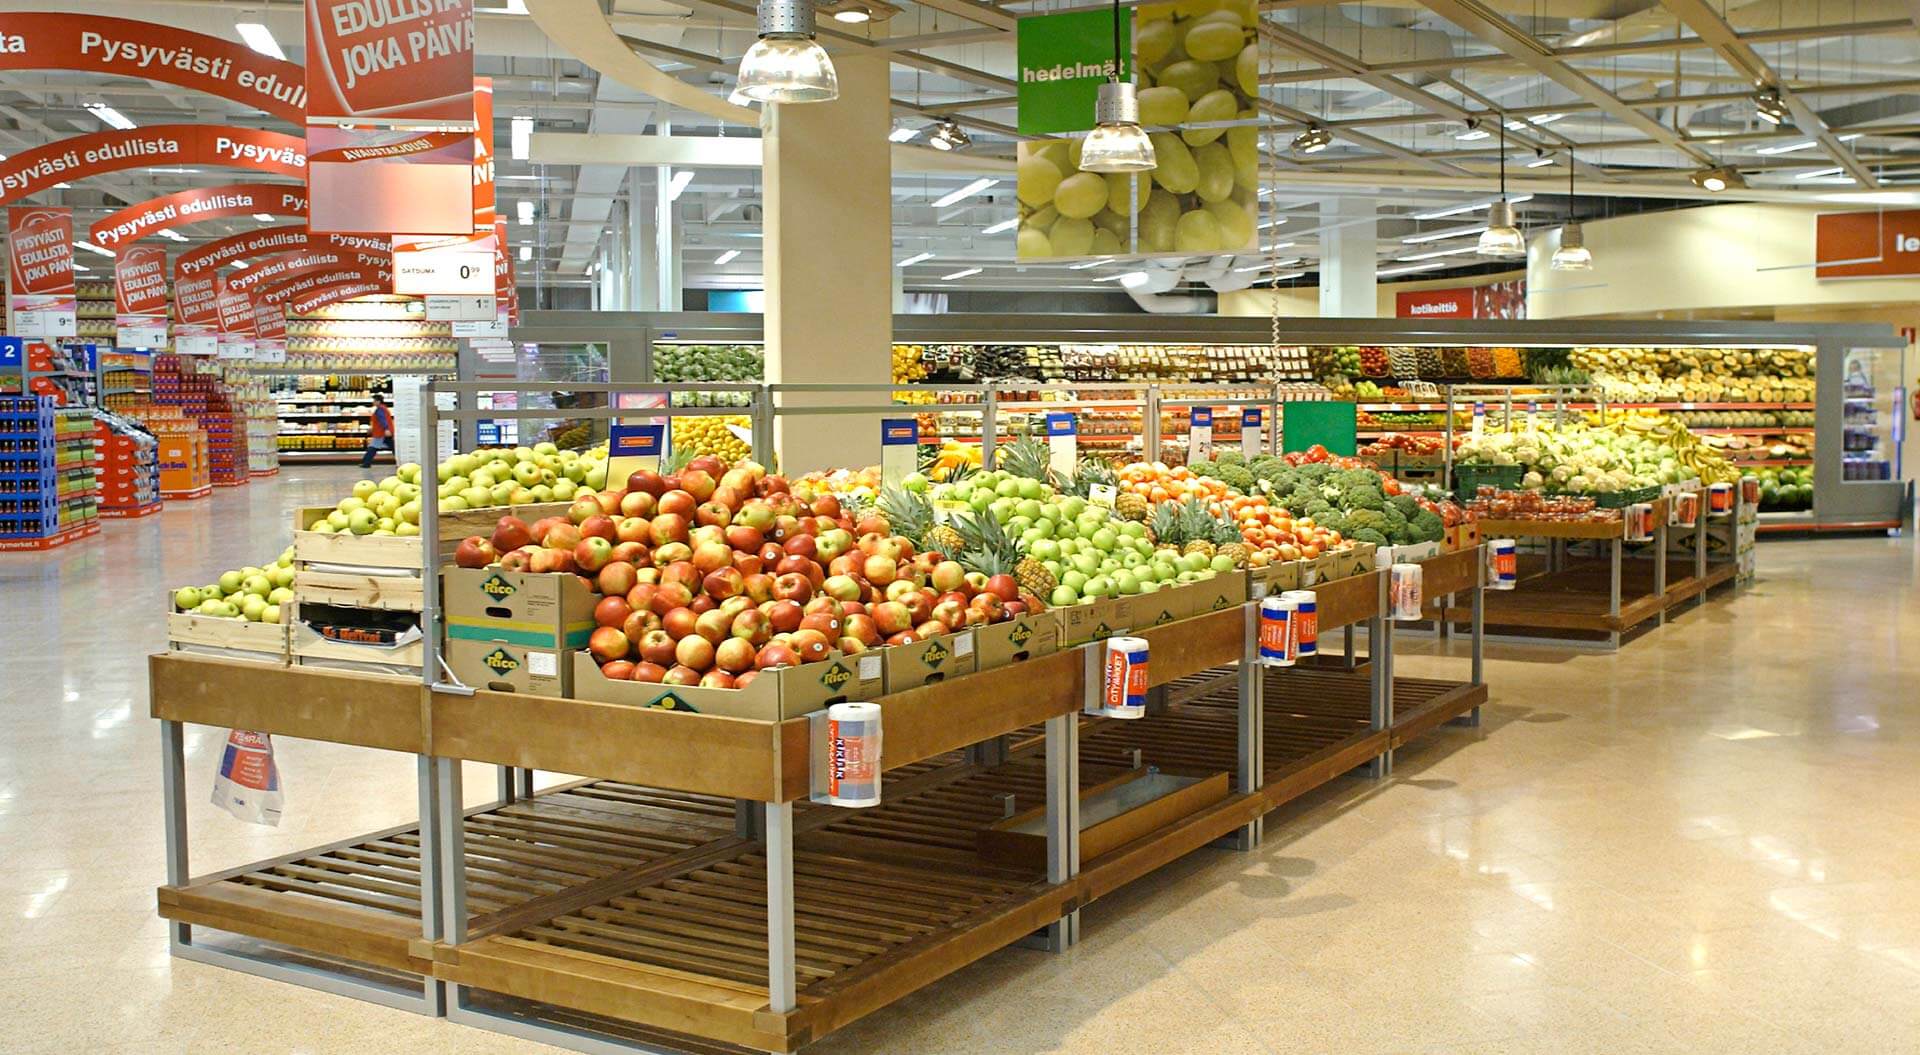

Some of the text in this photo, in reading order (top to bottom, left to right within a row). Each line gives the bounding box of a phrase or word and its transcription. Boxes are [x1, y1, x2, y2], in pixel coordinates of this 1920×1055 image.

[80, 31, 232, 80] Pysyvästi
[341, 36, 407, 89] JOKA
[84, 137, 179, 163] edullista
[95, 194, 253, 245] Pysyvästi edullista
[20, 243, 69, 266] EDULLISTA
[181, 234, 308, 274] Pysyvästi edullista
[24, 265, 49, 285] JOKA
[230, 253, 338, 290] Pysyvästi edullista
[265, 278, 314, 303] Pysyvästi
[315, 271, 361, 285] edullista
[295, 283, 380, 313] Pysyvästi edullista
[4, 345, 15, 358] 2
[484, 578, 514, 594] Rico
[1010, 627, 1033, 642] Rico
[487, 652, 517, 669] Rico
[924, 645, 949, 663] Rico
[824, 665, 850, 685] Rico
